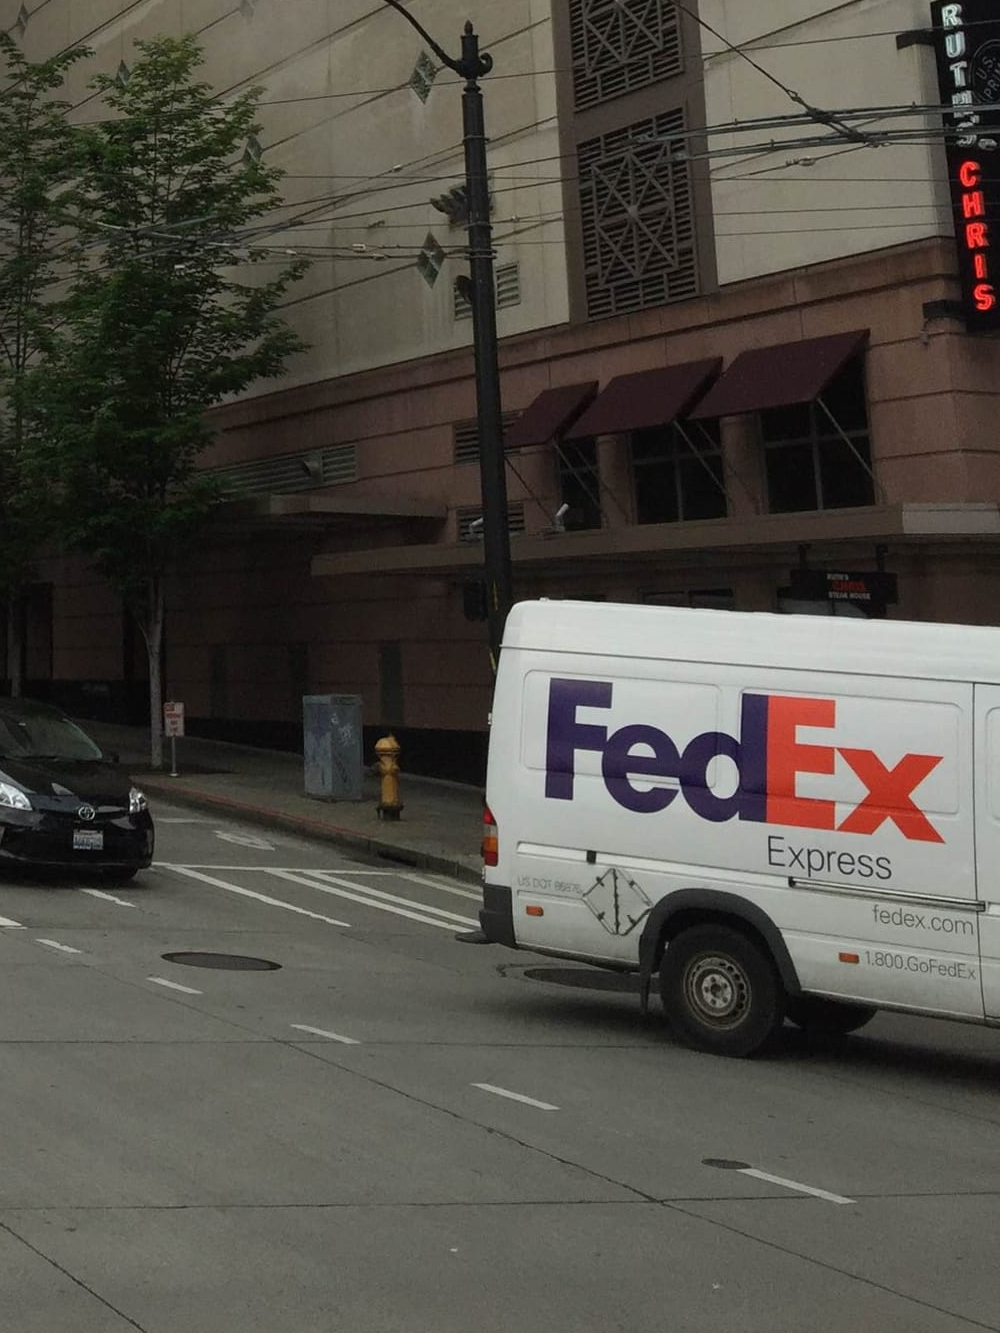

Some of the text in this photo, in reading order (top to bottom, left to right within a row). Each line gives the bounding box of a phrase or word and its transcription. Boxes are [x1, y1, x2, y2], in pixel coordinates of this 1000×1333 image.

[959, 160, 996, 312] CHRIS
[544, 677, 946, 844] FedEx
[767, 835, 893, 881] Express
[872, 904, 974, 935] fedex.com
[865, 951, 977, 980] 1.800.GoFedEx
